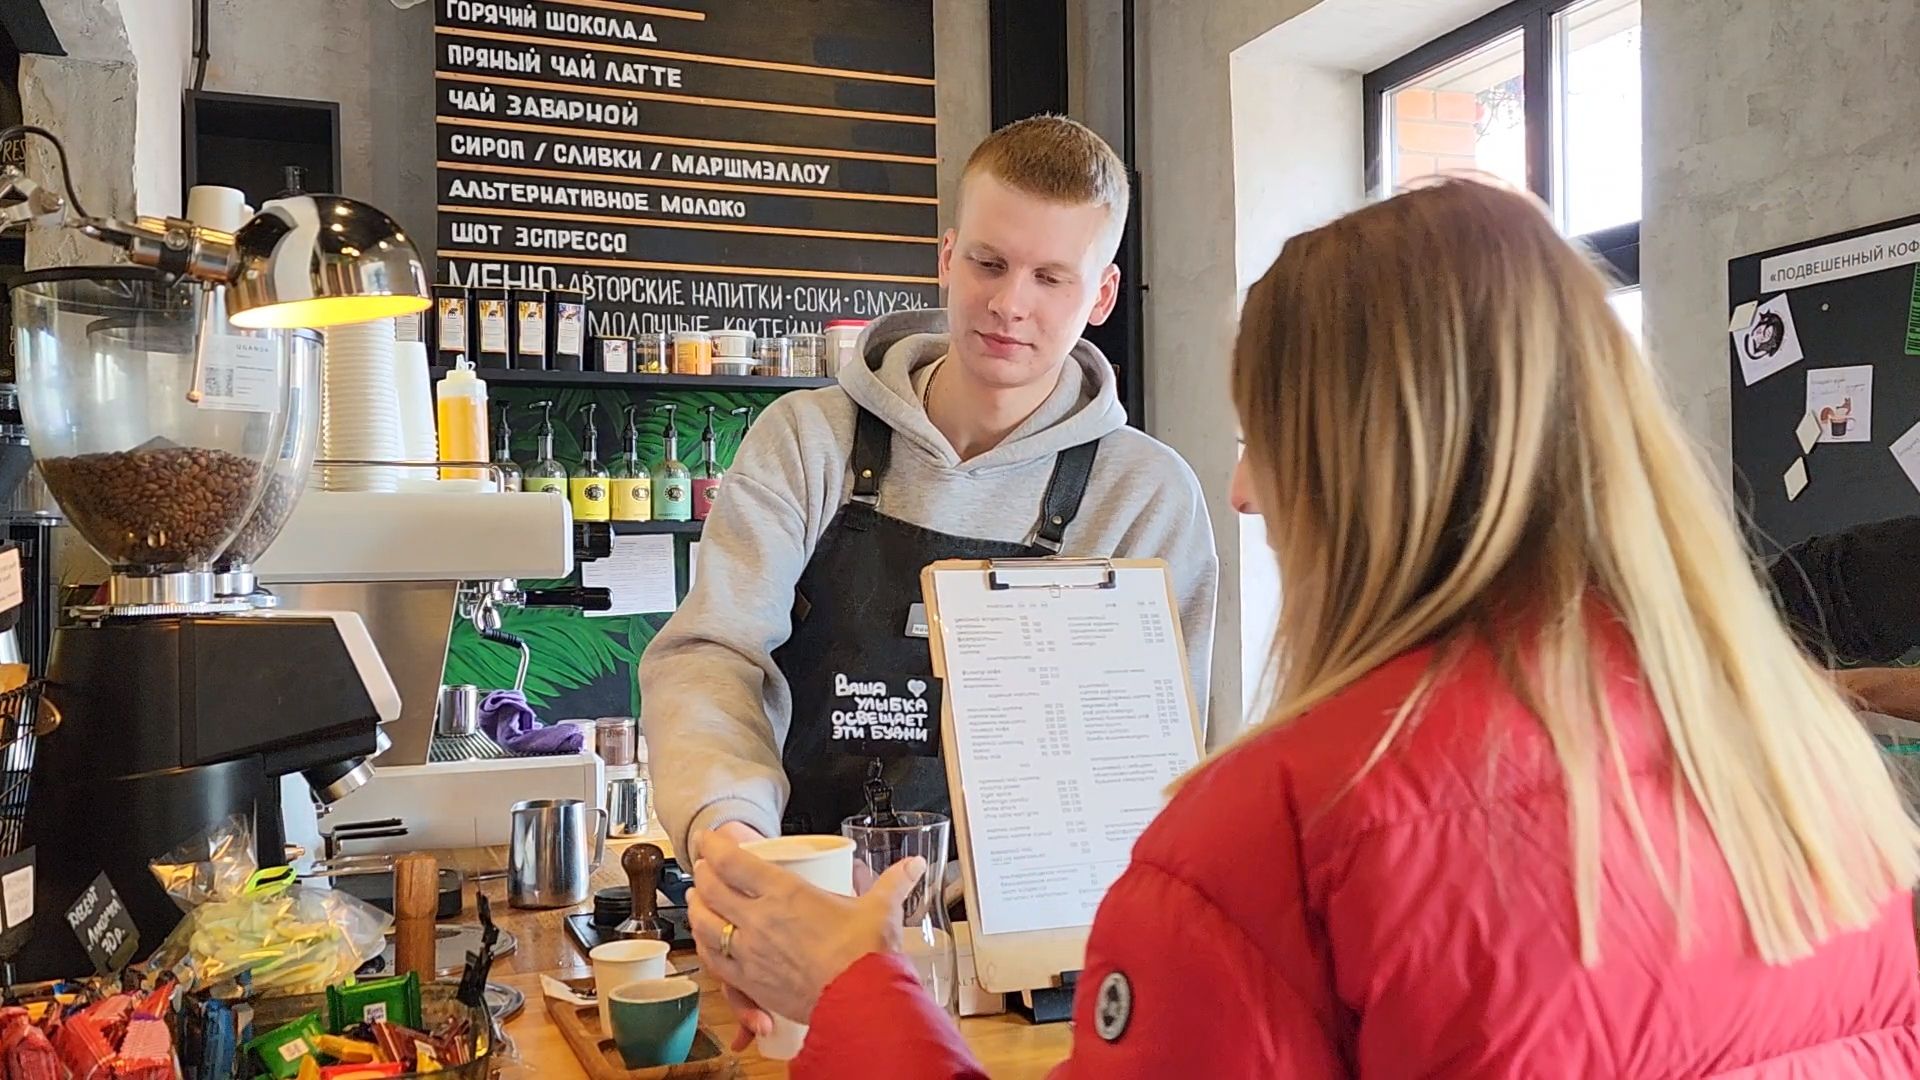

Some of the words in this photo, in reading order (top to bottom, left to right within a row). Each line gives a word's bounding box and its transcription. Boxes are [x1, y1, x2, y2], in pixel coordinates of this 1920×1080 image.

[446, 0, 537, 28] ГОРЯЧИЙ
[545, 10, 658, 42] ШОКОЛАД
[447, 44, 541, 74] ПРЯНЫЙ
[550, 53, 597, 79] ЧАЙ
[605, 61, 682, 88] ЛАТТЕ
[448, 87, 496, 113] ЧАЙ
[506, 94, 639, 126] ЗАВАРНОЙ
[450, 134, 525, 160] СИРОП
[553, 143, 642, 170] СЛИВКИ
[671, 153, 831, 186] МАРШМЭЛЛОУ
[449, 179, 649, 212] АЛЬТЕРНАТИВНОЕ
[661, 194, 746, 218] МОЛОКО
[451, 222, 503, 246] ШОТ
[515, 226, 628, 253] ЭСПРЕССО
[1769, 244, 1884, 283] «ПОДВЕШЕННЫЙ
[831, 710, 929, 727] ОСВЕЩАЕТ
[854, 696, 928, 713] УЛЫБКА
[832, 725, 865, 741] ЭТИ
[870, 725, 928, 742] БУДНИ
